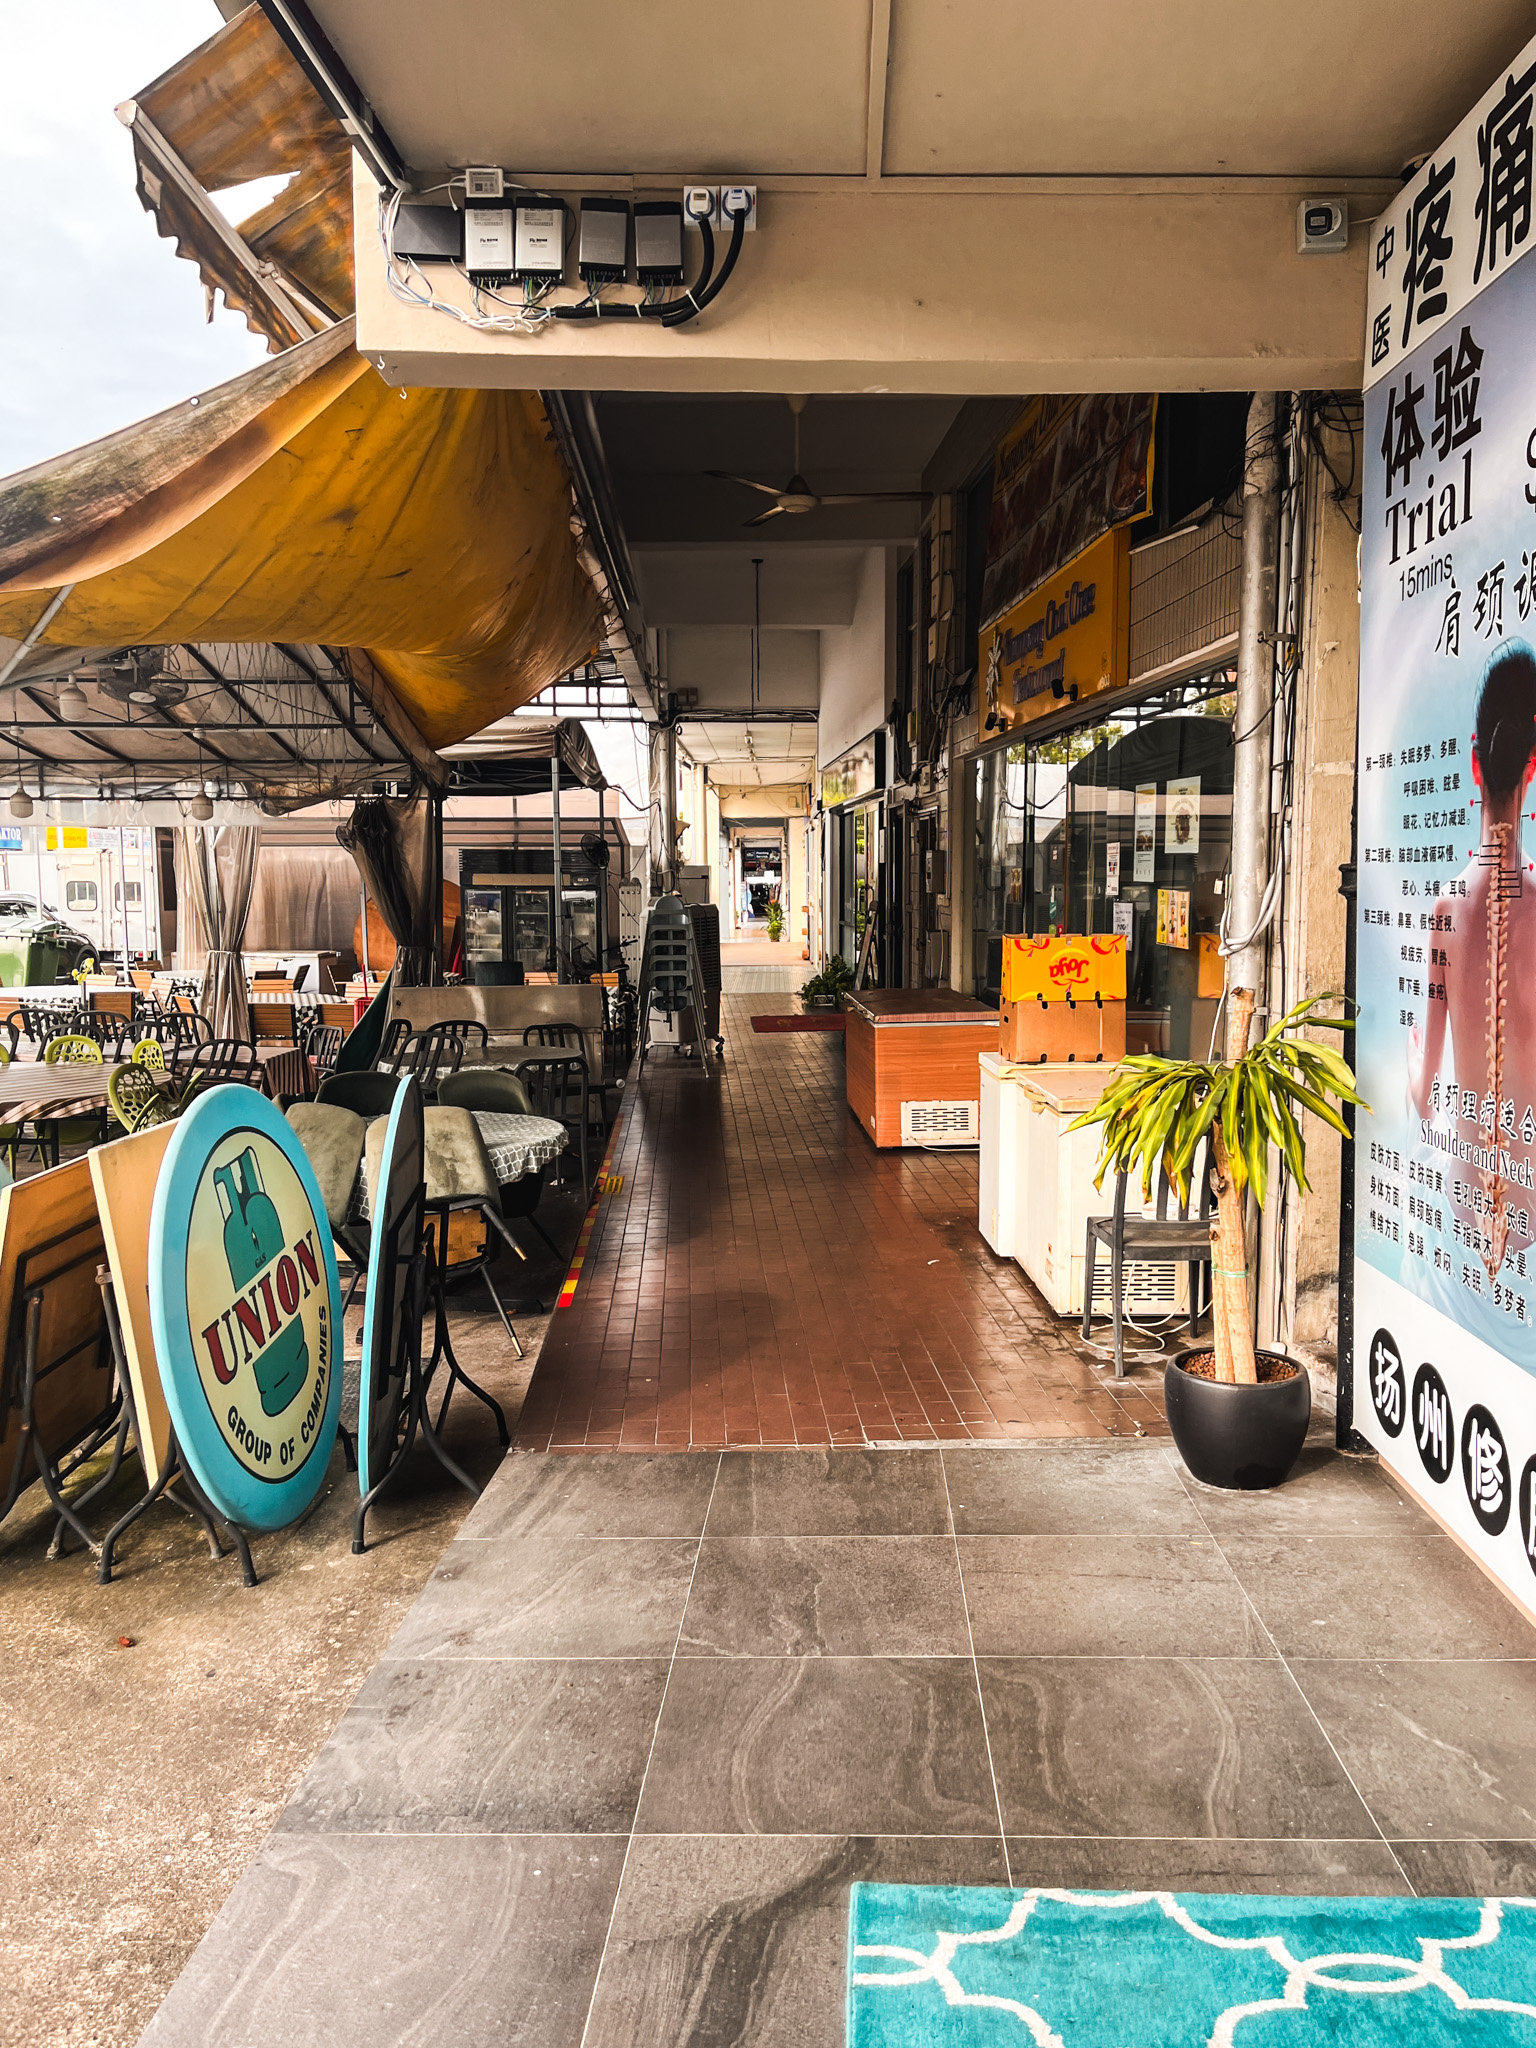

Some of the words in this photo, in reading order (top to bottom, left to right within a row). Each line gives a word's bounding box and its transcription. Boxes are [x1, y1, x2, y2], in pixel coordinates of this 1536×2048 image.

[1402, 60, 1536, 348] 疼痛
[1371, 225, 1395, 367] 中医
[1381, 326, 1484, 499] 体验
[1386, 448, 1472, 565] Trial
[1399, 553, 1452, 601] 15mins
[1049, 957, 1090, 978] Joya
[1420, 1119, 1472, 1162] Shoulder
[1473, 1145, 1498, 1174] and
[1500, 1150, 1534, 1189] Neck
[202, 1229, 320, 1385] UNION
[228, 1405, 272, 1464] GROUP
[279, 1437, 295, 1465] OF
[300, 1305, 327, 1444] COMPANIES
